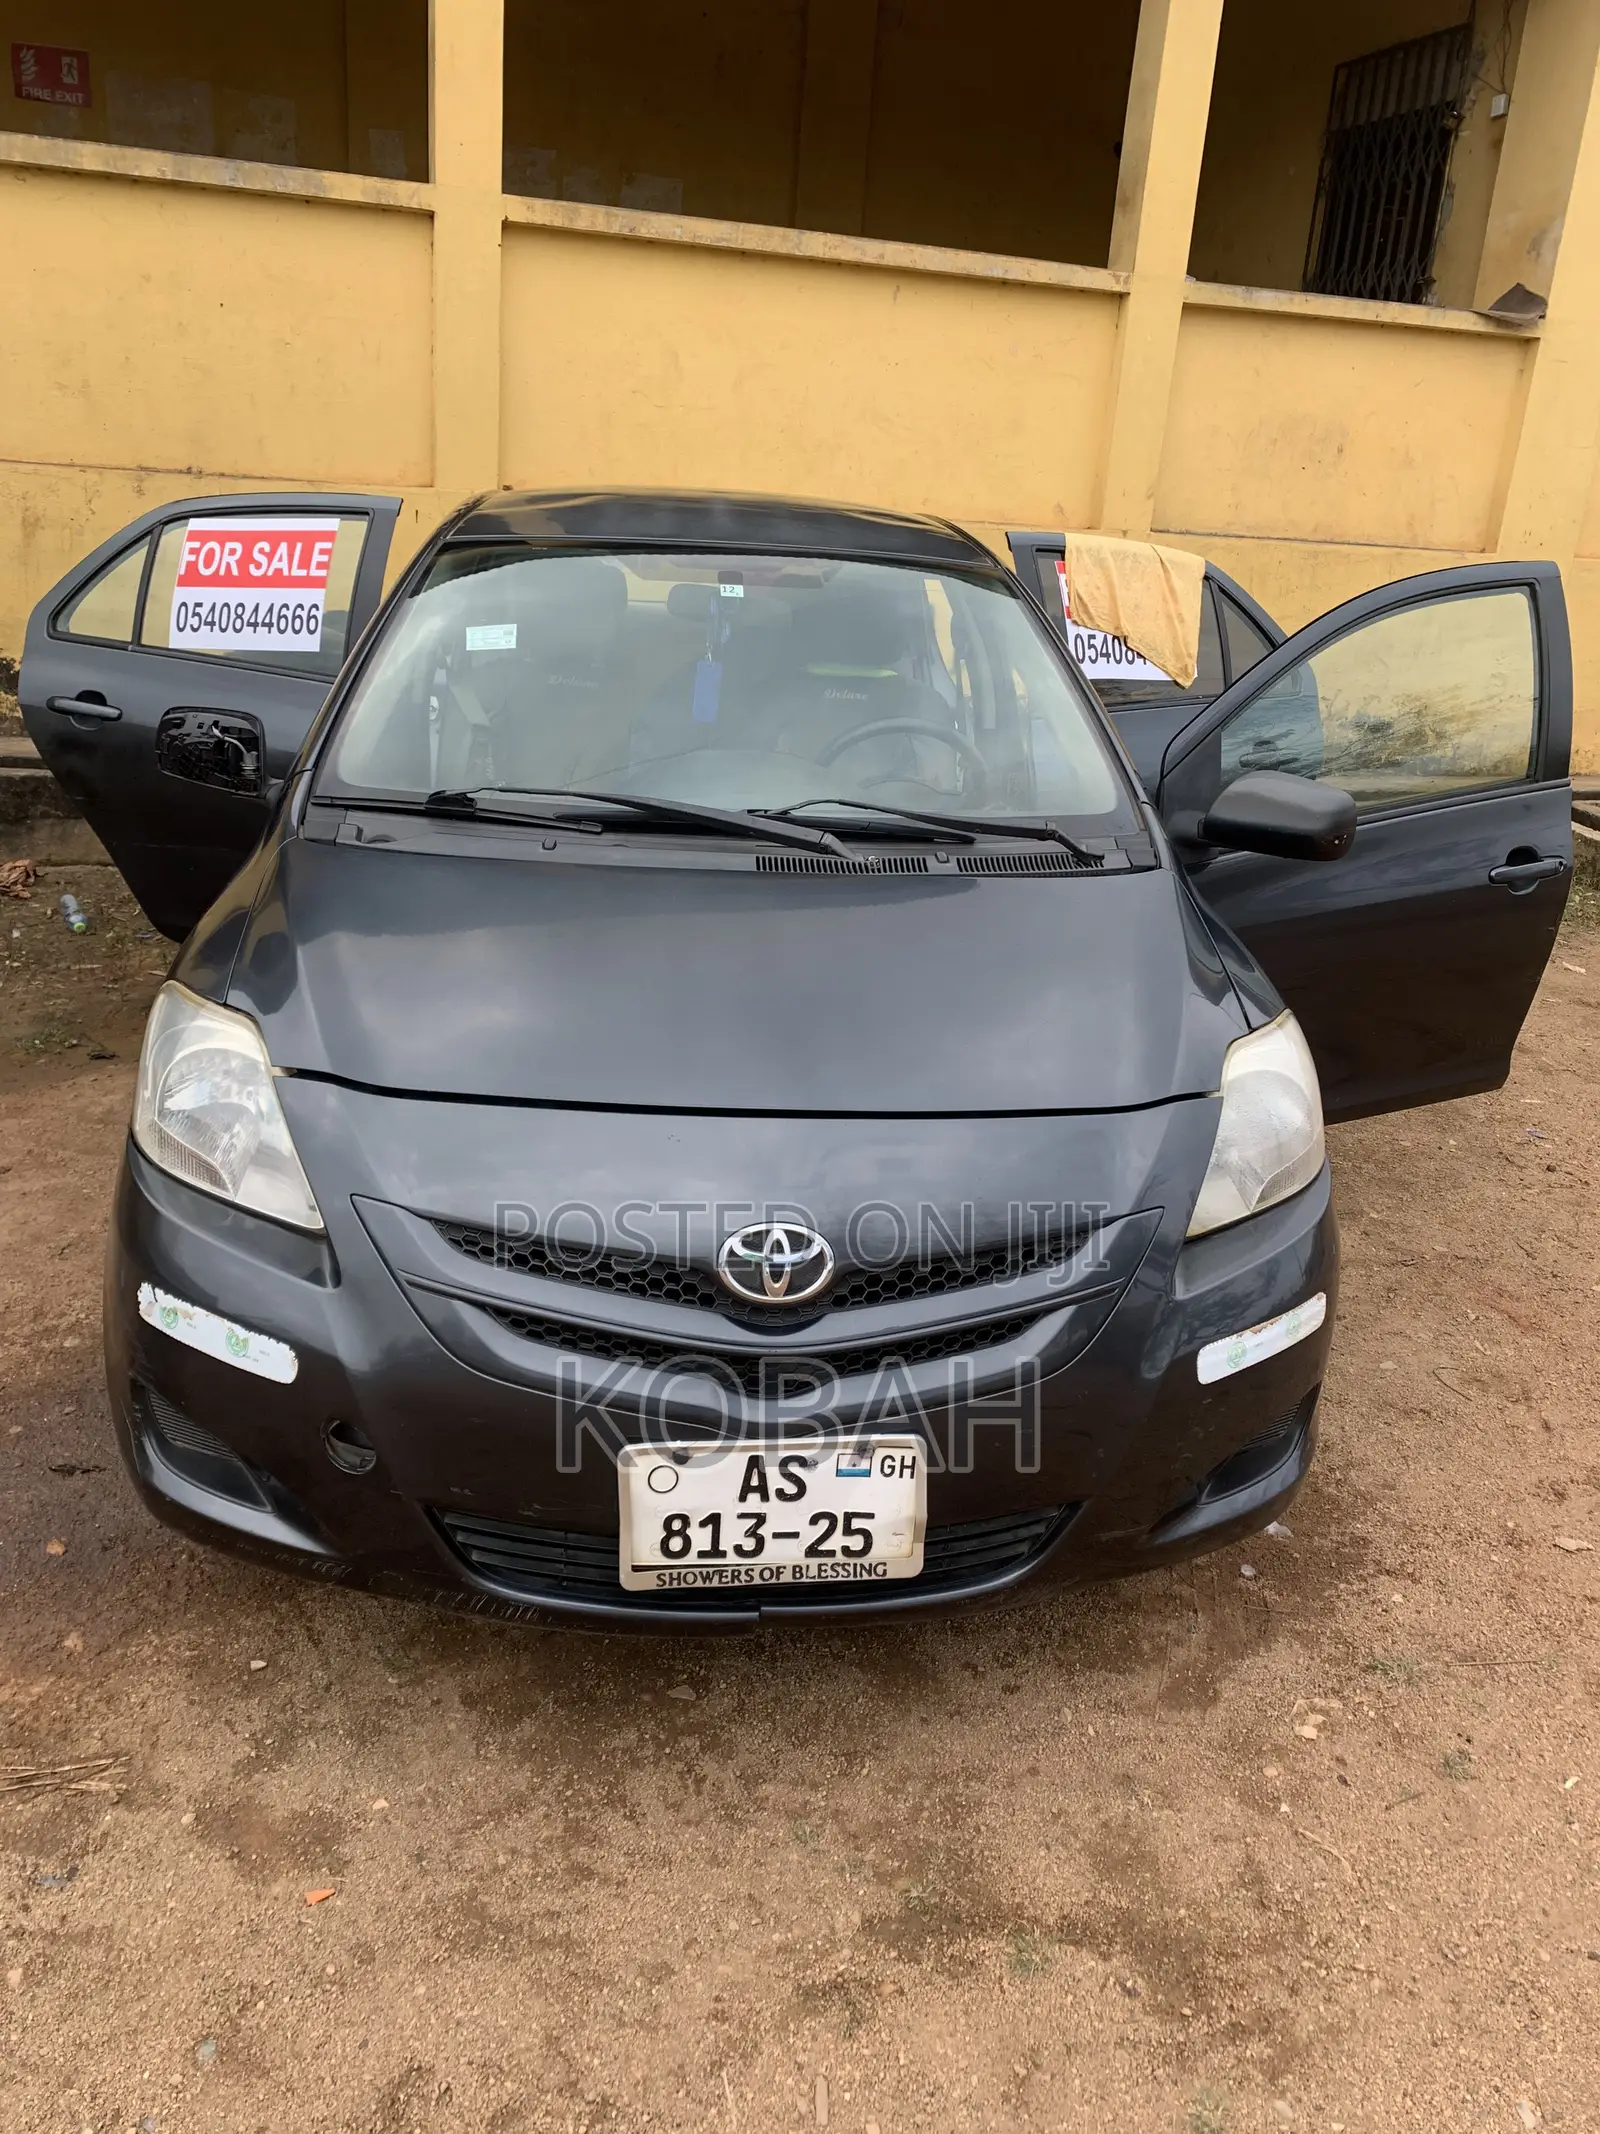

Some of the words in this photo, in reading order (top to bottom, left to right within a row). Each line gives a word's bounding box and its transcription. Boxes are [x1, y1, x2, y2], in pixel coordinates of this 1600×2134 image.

[22, 86, 52, 101] FIRE
[55, 90, 86, 105] EXIT
[179, 541, 243, 576] FOR
[249, 541, 332, 576] SALE
[176, 601, 320, 636] 0540844666
[1074, 633, 1147, 666] 05408
[738, 1454, 808, 1503] AS
[879, 1454, 917, 1480] GH
[658, 1511, 876, 1560] 813-25
[655, 1567, 755, 1588] SHOWERS
[758, 1564, 787, 1583] OF
[791, 1561, 888, 1581] BLESSING
